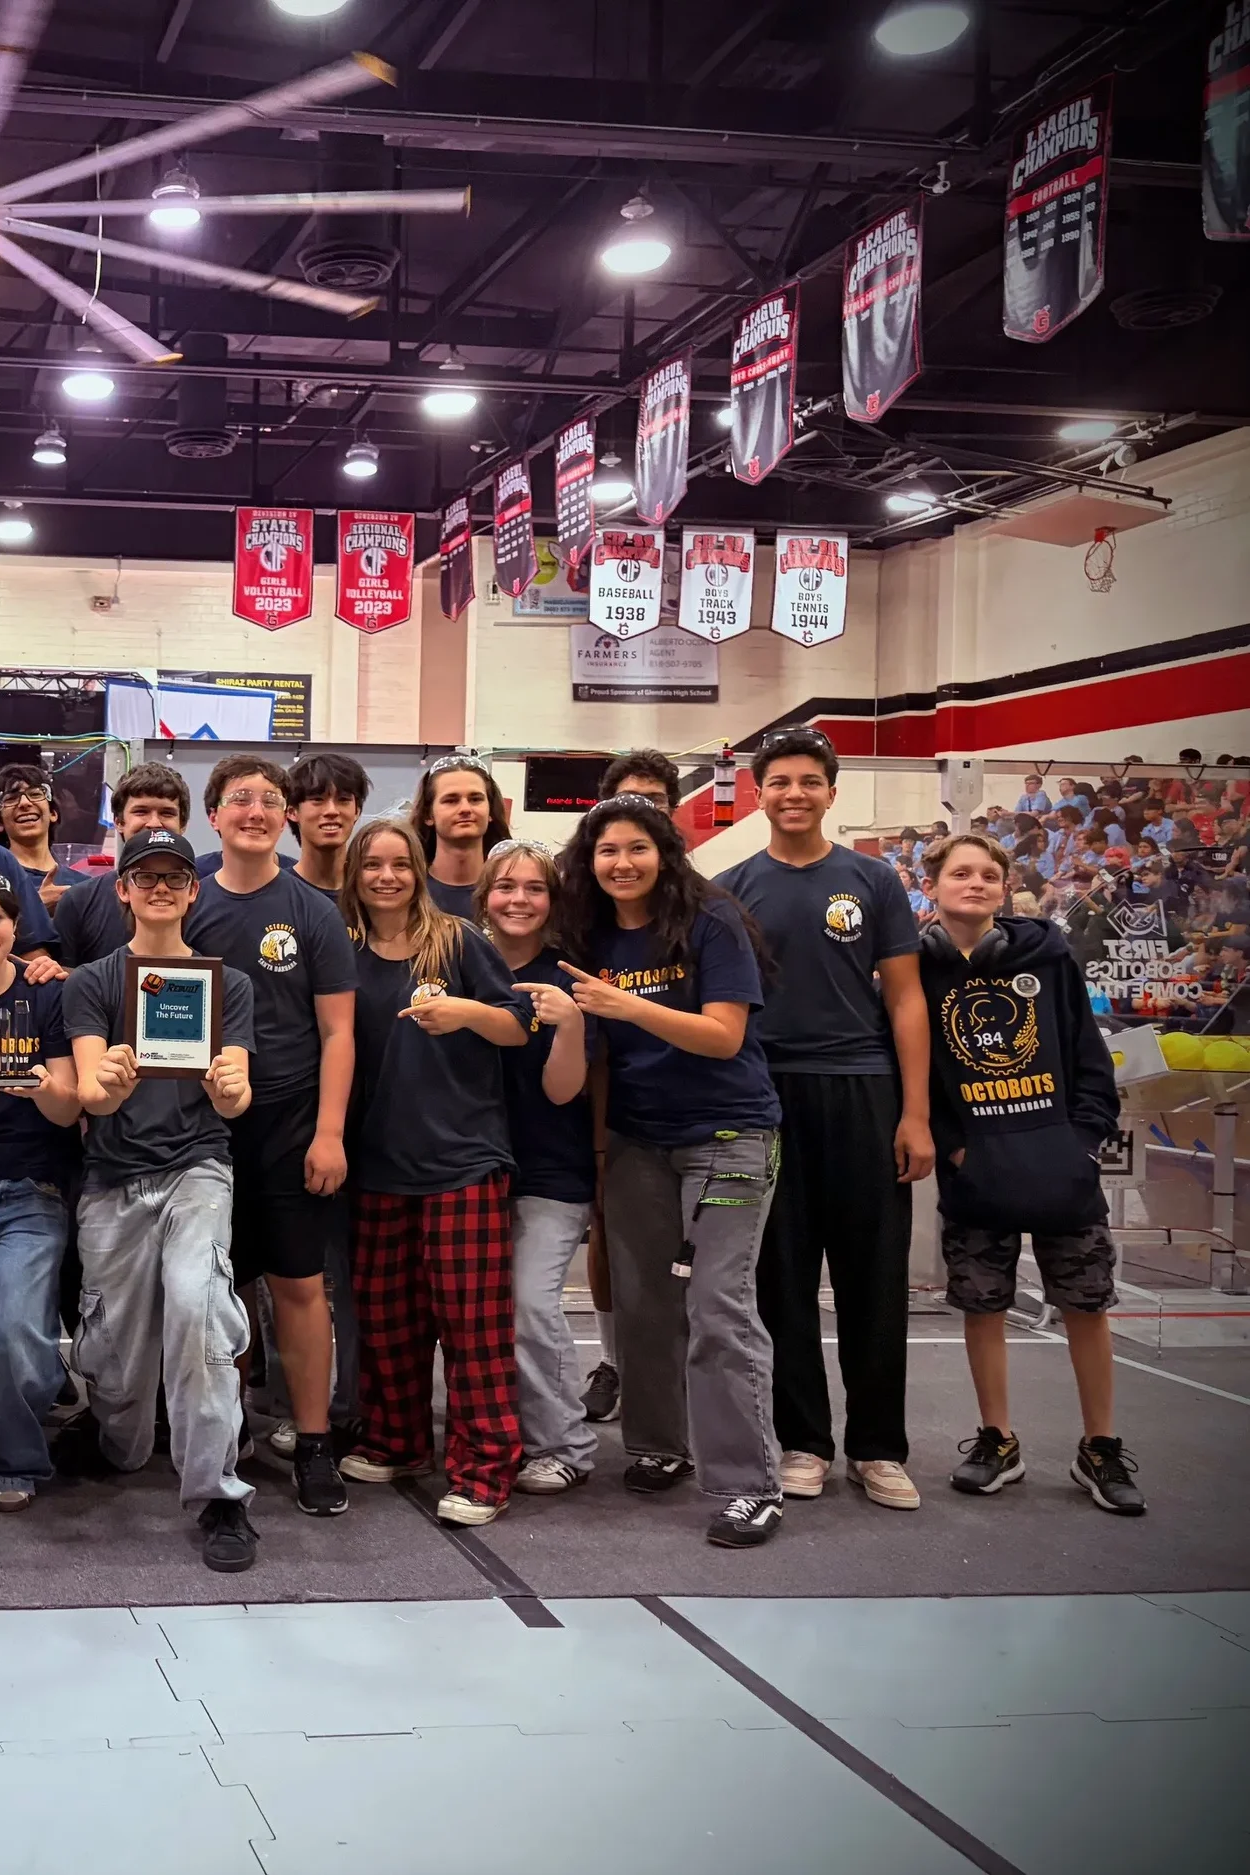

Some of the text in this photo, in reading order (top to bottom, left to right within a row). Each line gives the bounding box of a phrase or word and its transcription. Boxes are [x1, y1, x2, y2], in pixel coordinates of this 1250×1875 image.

[1026, 97, 1092, 154] LEAGUE
[1012, 115, 1099, 191] CHAMPIONS
[1031, 172, 1078, 206] FOOTBALL
[857, 211, 907, 261] LEAGUE
[848, 228, 918, 294] CHAMPIONS
[741, 297, 785, 336] LEAGUE
[647, 360, 683, 394] LEAGUE
[645, 374, 688, 411] HAMPIONS
[559, 421, 588, 450] LEAGUE
[252, 510, 288, 518] DIVISION
[251, 519, 296, 533] STATE
[352, 524, 401, 537] REGIONAL
[245, 532, 303, 552] CHAMPIONS
[345, 535, 408, 556] CHAMPIONS
[260, 577, 287, 586] GIRLS
[358, 578, 389, 588] GIRLS
[244, 586, 303, 597] VOLLEYBALL
[346, 588, 404, 600] VOLLEYBALL
[598, 587, 655, 600] BASEBALL
[705, 588, 729, 597] BOYS
[798, 592, 822, 602] BOYS
[255, 598, 292, 611] 2023
[354, 601, 392, 615] 2023
[700, 598, 734, 609] TRACK
[790, 602, 829, 613] TENNIS
[605, 606, 645, 622] 1938
[697, 609, 737, 625] 1943
[791, 613, 829, 629] 1944
[650, 638, 684, 646] ALBERTO
[577, 650, 637, 660] FARMERS
[649, 649, 676, 657] AGENT
[215, 678, 305, 688] SHIRAZ PARTY RENTAL
[610, 688, 636, 696] Sponsor
[159, 1003, 189, 1011] Uncover
[156, 1011, 193, 1019] The Future
[960, 1072, 1055, 1103] OCTOBOTS
[971, 1098, 1053, 1117] SANTA BARBARA
